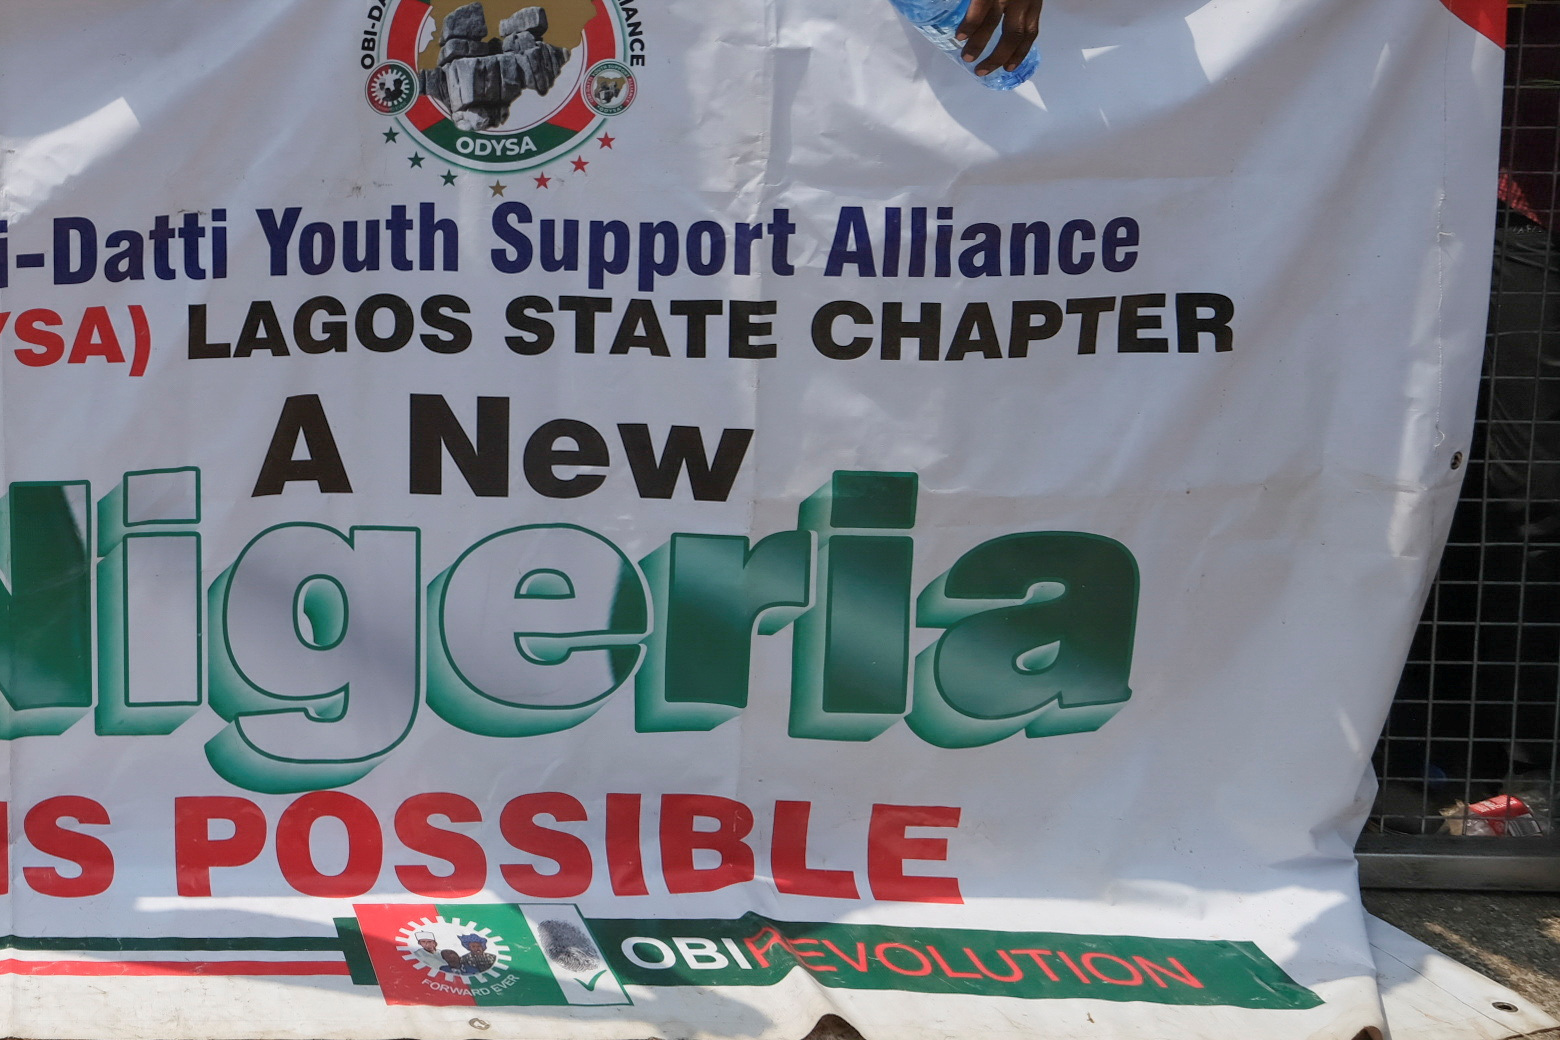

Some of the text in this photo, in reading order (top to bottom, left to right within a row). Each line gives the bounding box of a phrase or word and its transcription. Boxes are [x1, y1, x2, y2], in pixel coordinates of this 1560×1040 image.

[455, 136, 538, 157] ODYSA
[255, 202, 459, 277] Youth
[489, 201, 797, 292] Support
[823, 206, 1141, 279] Alliance
[187, 293, 472, 360] LAGOS
[503, 295, 777, 359] STATE
[810, 292, 1235, 361] CHAPTER
[251, 393, 756, 503] A New
[173, 789, 965, 907] POSSIBLE
[421, 973, 521, 998] FORWARD EVER
